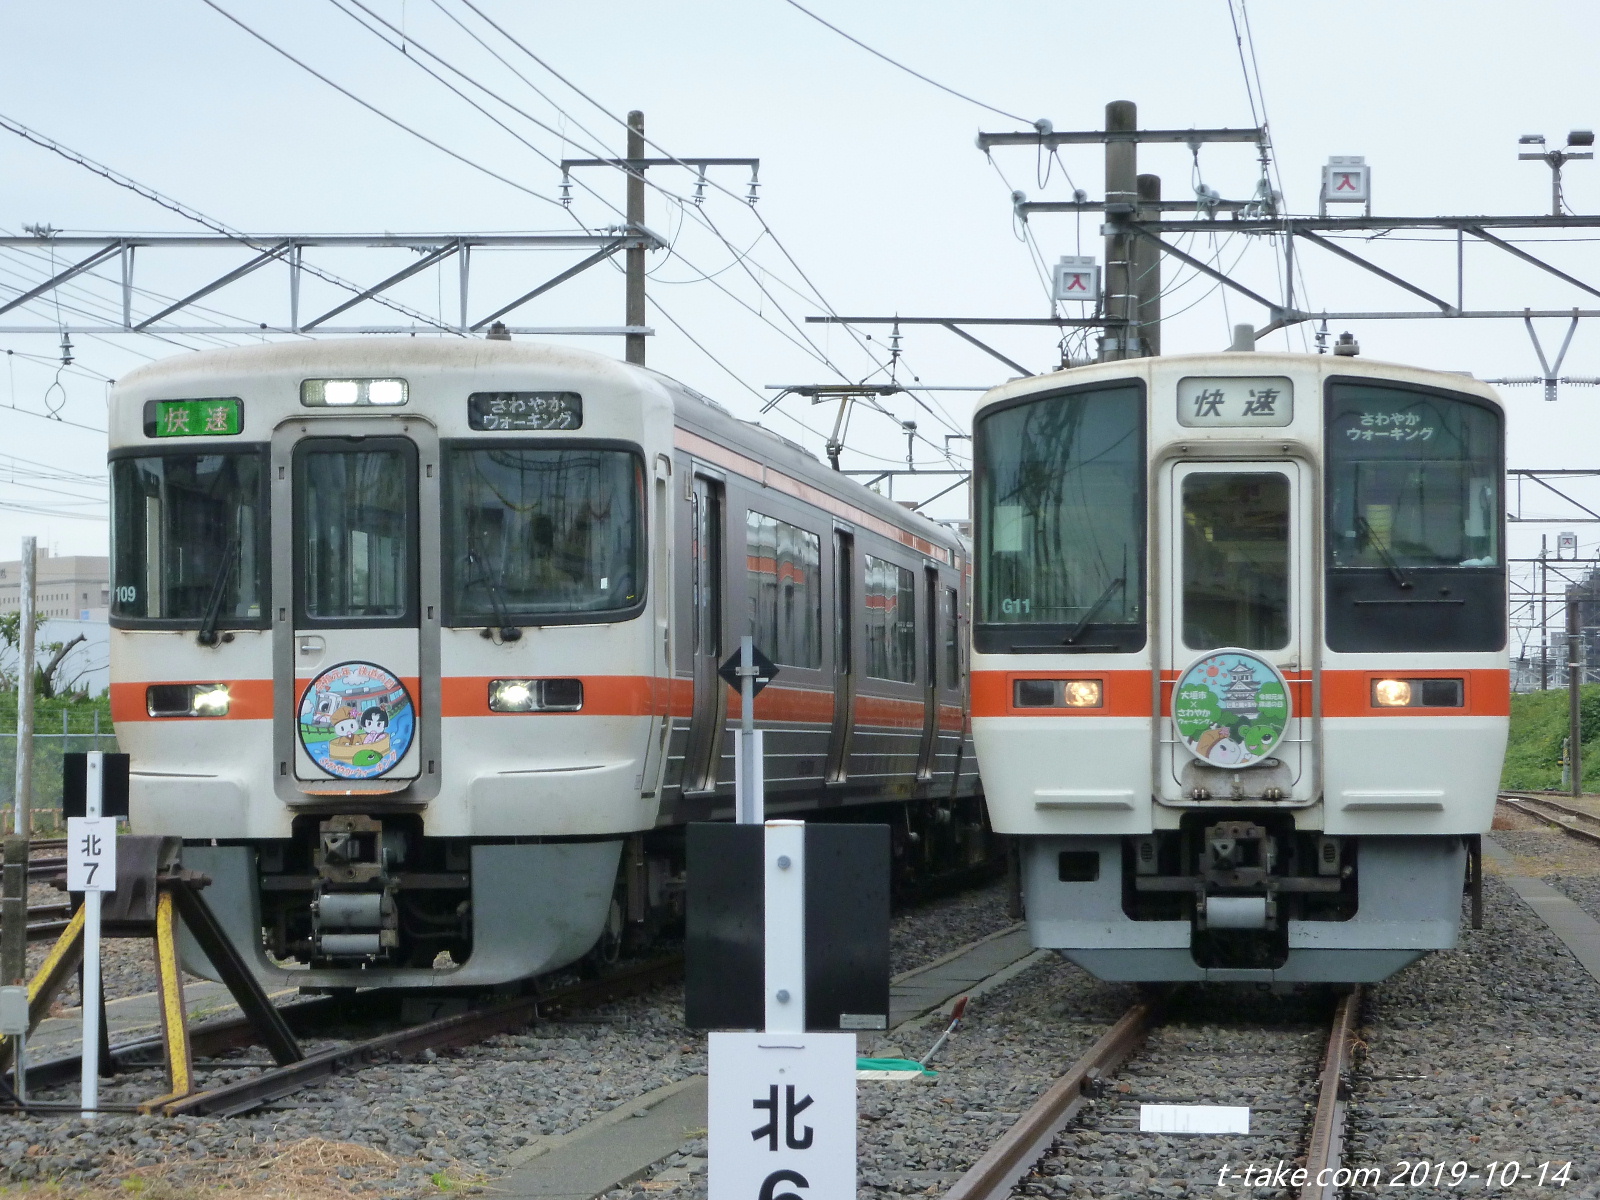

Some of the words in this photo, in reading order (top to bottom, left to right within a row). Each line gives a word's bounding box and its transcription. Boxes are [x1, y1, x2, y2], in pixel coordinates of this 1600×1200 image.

[1336, 173, 1356, 191] 入
[1067, 274, 1086, 290] 入
[490, 396, 566, 413] さわやか
[1194, 388, 1280, 417] 快速
[164, 406, 229, 432] 快速
[483, 411, 572, 430] ウォーキング
[1360, 412, 1420, 426] さわやか
[1346, 427, 1434, 441] ウォーキング
[1002, 598, 1030, 613] G11
[1177, 709, 1211, 718] さわやか
